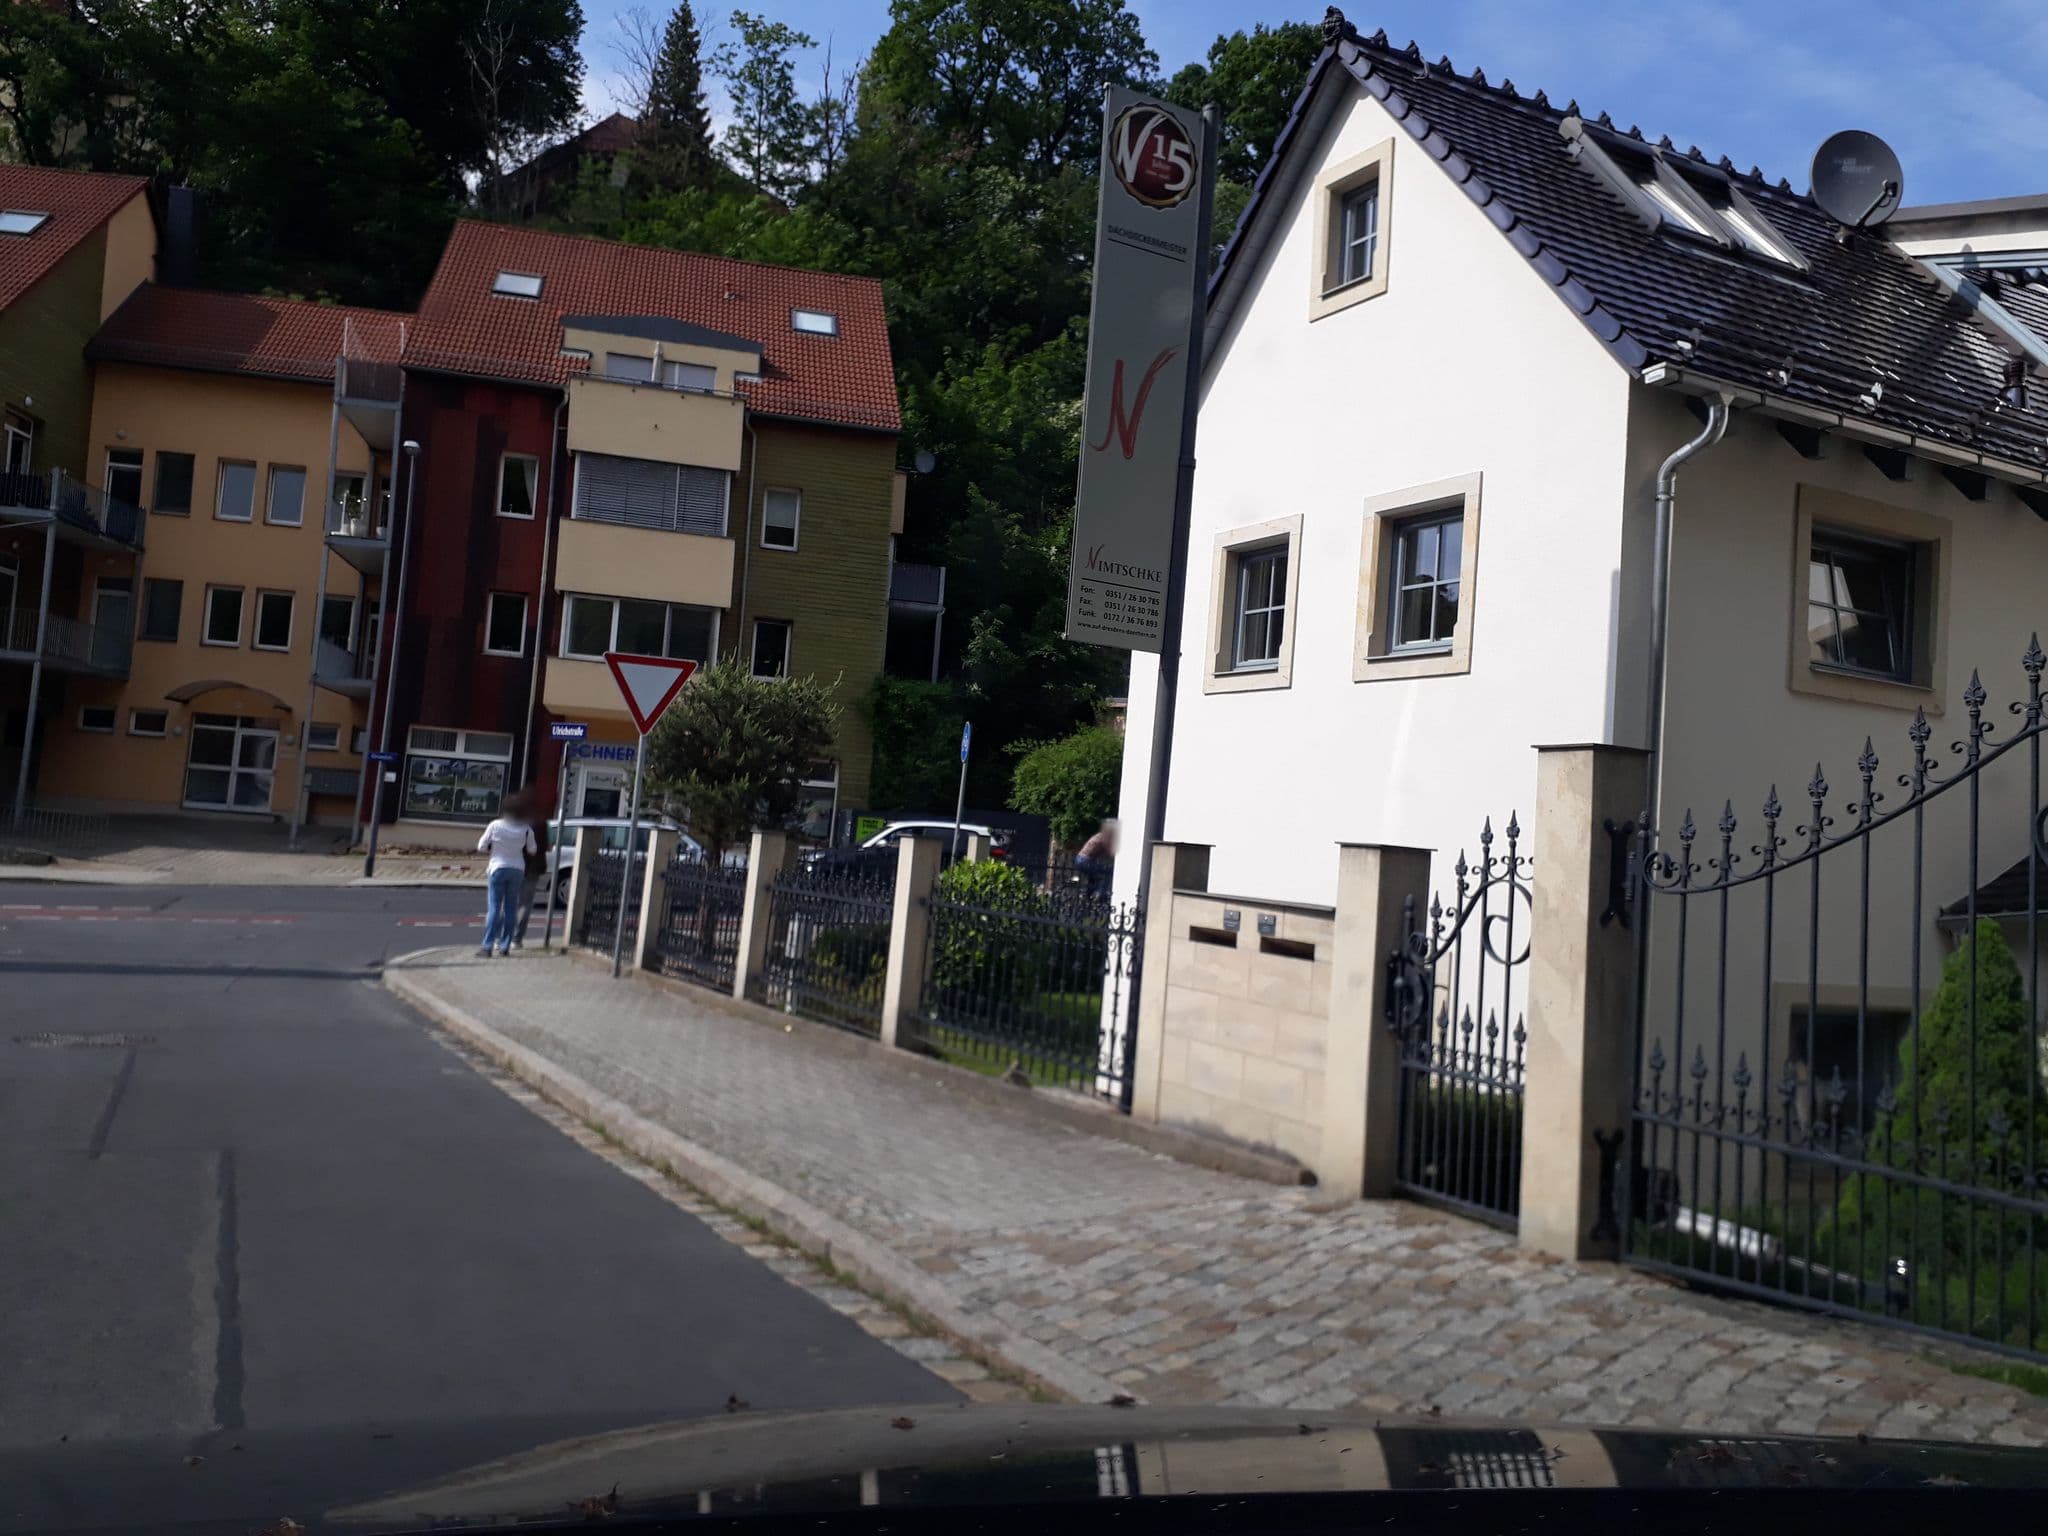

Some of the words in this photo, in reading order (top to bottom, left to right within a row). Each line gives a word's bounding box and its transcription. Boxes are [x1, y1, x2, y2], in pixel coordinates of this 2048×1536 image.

[1085, 544, 1162, 583] NIMTSCHKE
[1080, 585, 1096, 594] Fon:
[1105, 589, 1122, 600] 0351
[1128, 594, 1137, 602] 26
[1138, 595, 1147, 604] 30
[1079, 596, 1093, 606] Fax:
[1104, 601, 1121, 611] 0351
[1127, 605, 1136, 613] 26
[1137, 606, 1146, 615] 30
[1078, 608, 1097, 618] Funk:
[1103, 612, 1120, 622] 0172
[1126, 616, 1135, 625] 36
[1136, 617, 1145, 626] 76
[1145, 619, 1158, 628] 893
